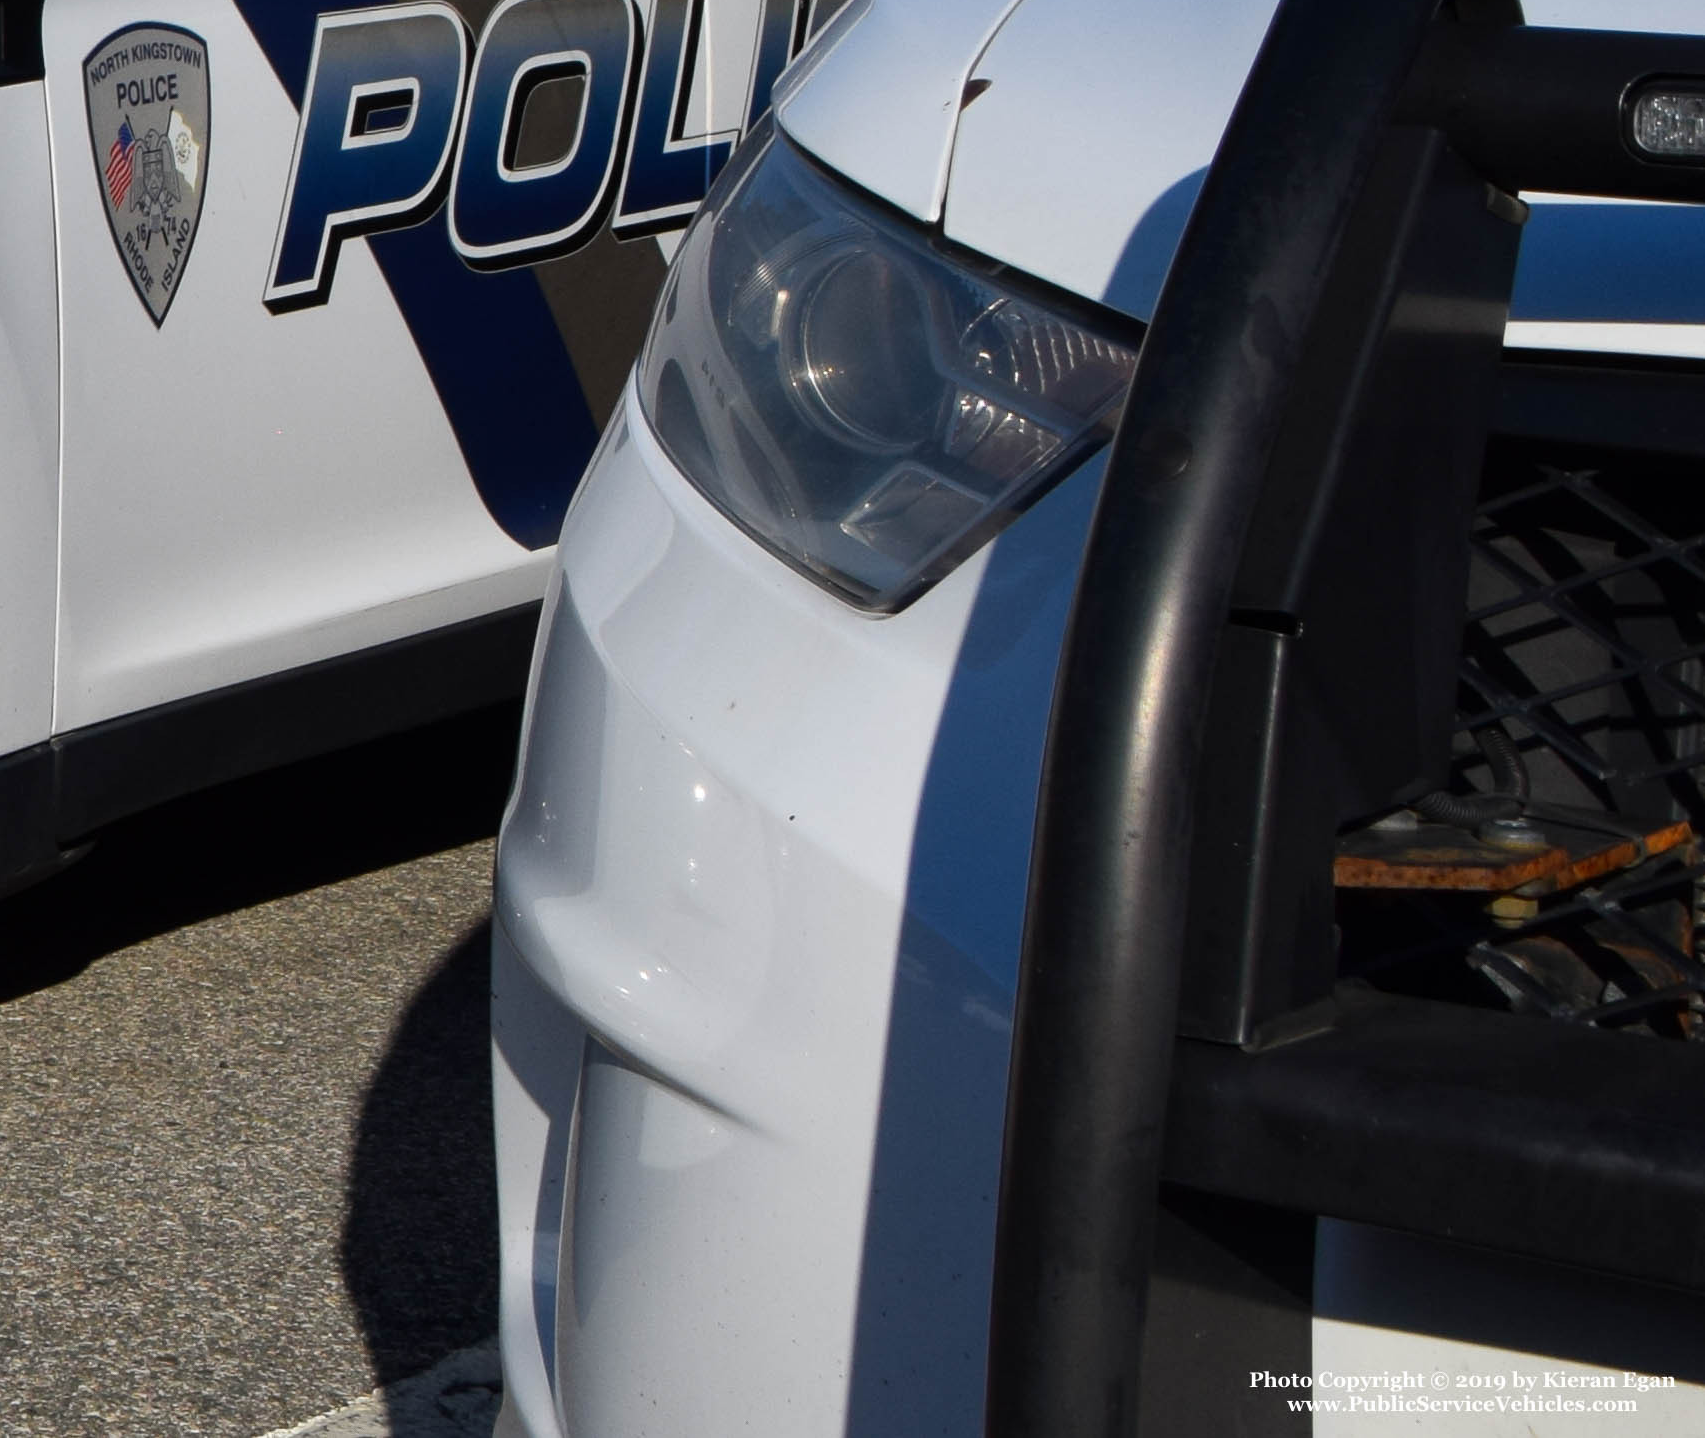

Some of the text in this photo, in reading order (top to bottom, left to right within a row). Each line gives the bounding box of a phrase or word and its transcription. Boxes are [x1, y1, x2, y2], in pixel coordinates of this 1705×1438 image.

[90, 42, 202, 88] NORTH KINGSTOWN
[116, 73, 179, 109] POLICE
[123, 230, 154, 294] RHODE
[161, 217, 190, 292] ISLAND
